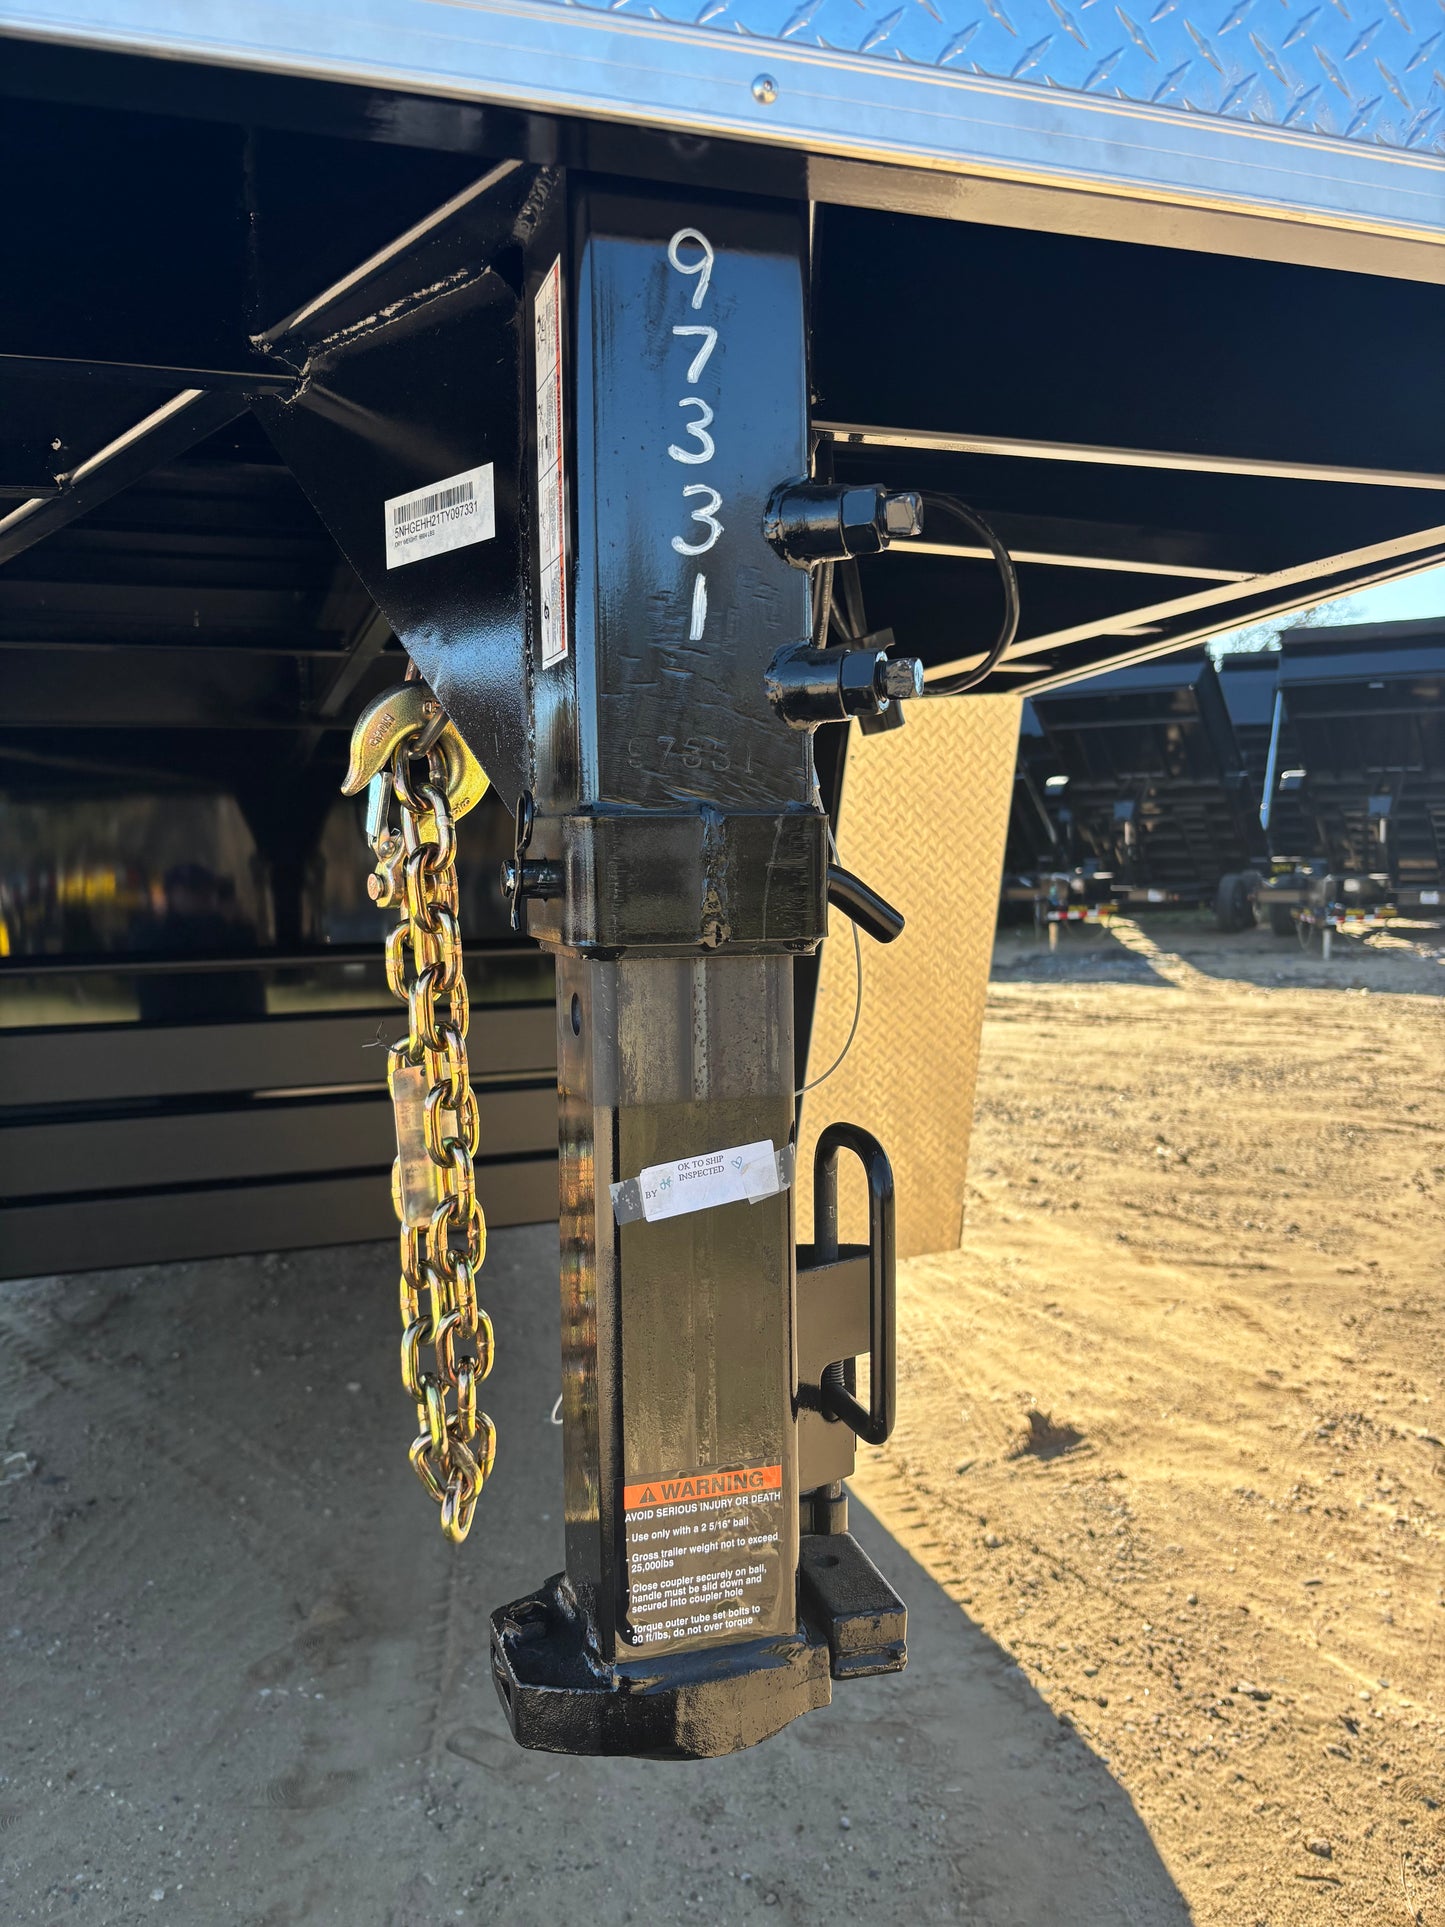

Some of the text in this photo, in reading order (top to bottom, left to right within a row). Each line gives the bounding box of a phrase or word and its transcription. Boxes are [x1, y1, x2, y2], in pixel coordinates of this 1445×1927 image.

[394, 500, 478, 539] 5NHGEHH21TY097331
[678, 1156, 723, 1171] OK TO SHIP
[679, 1166, 724, 1181] INSPECTED
[645, 1190, 657, 1199] BY
[661, 1471, 763, 1500] WARNING
[625, 1491, 781, 1522] AVOID SERIOUS INJURY OR DEATH
[632, 1532, 649, 1542] Use
[652, 1528, 670, 1540] only
[673, 1525, 690, 1535] with
[701, 1523, 707, 1531] 2
[733, 1516, 749, 1527] ball
[632, 1532, 778, 1563] Gross trailer weight not to exceed
[632, 1558, 674, 1573] 25,000lbs
[633, 1564, 767, 1592] Close coupler securely on ball,
[632, 1575, 762, 1603] handle must be slid down and
[632, 1588, 744, 1613] secured into coupler hole
[632, 1617, 753, 1644] 90 ft/lbs, do not over torque
[633, 1605, 761, 1635] Torque outer tube set bolts to
